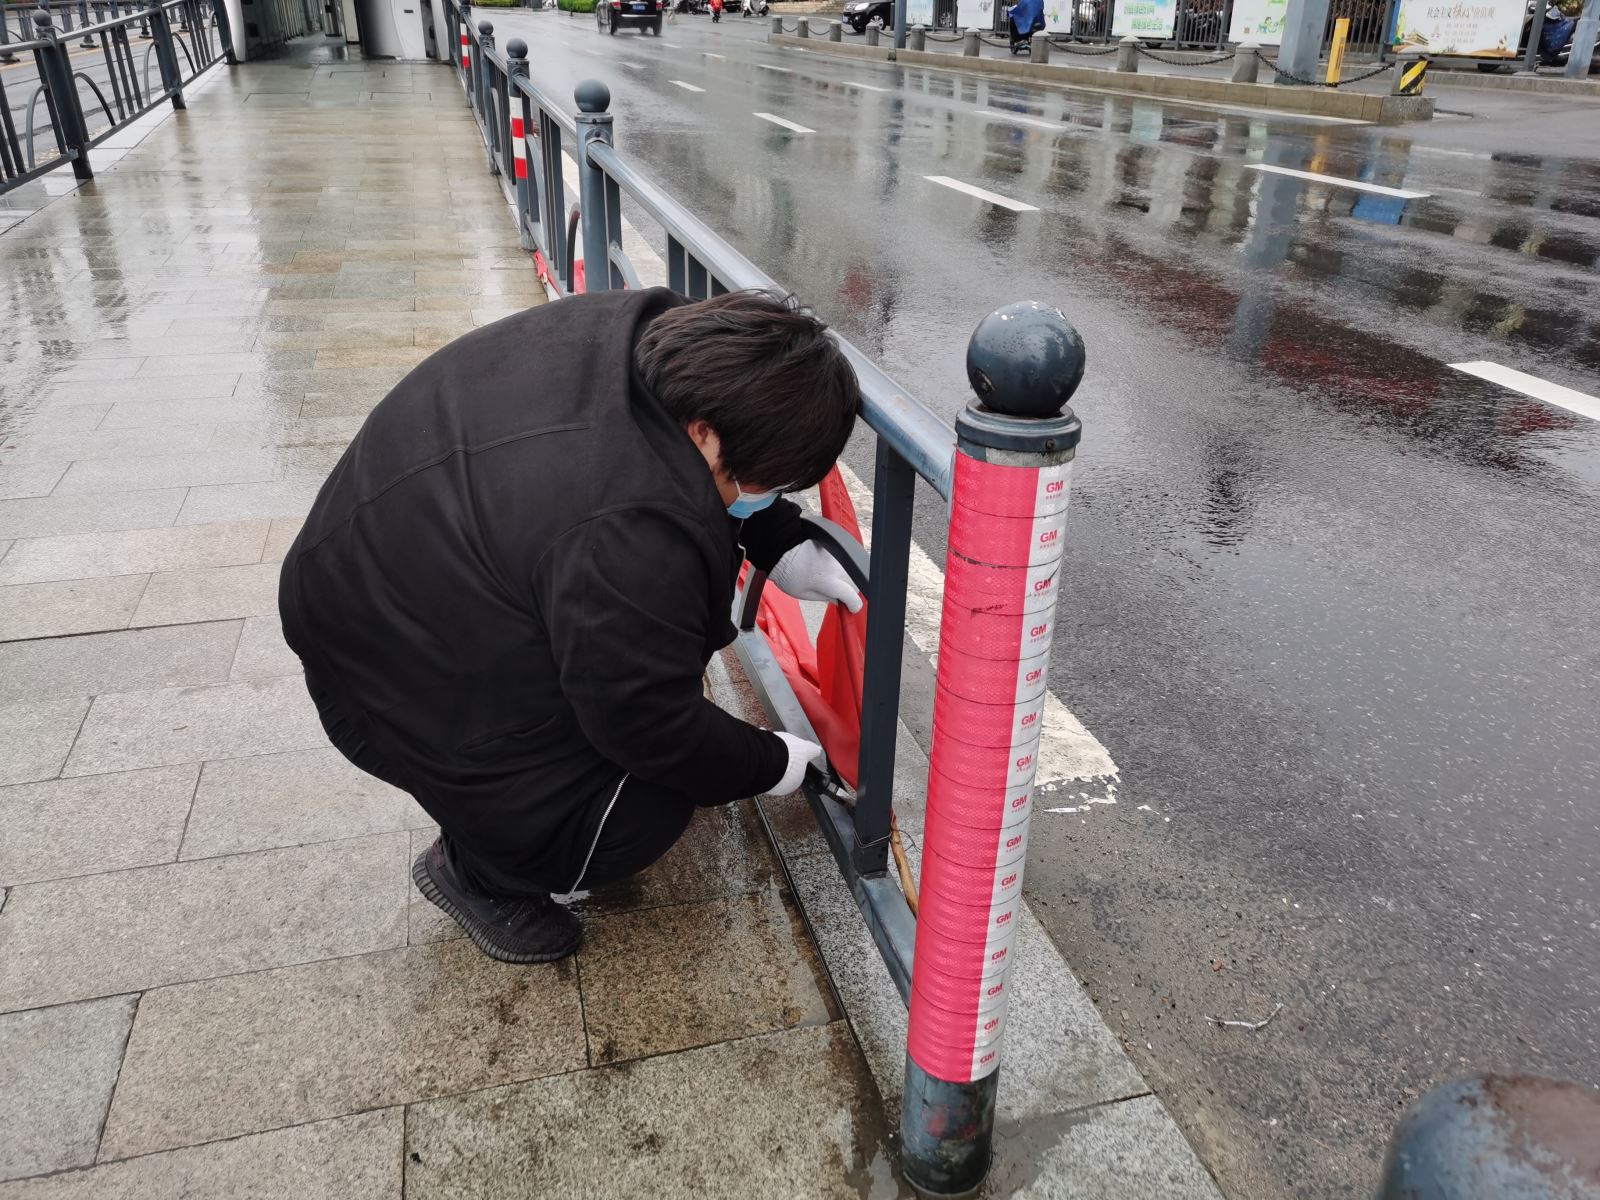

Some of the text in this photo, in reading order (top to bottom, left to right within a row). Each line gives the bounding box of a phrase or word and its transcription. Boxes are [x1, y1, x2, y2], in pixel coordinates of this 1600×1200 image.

[1046, 480, 1064, 494] GM
[1040, 529, 1057, 542] GM
[1034, 579, 1051, 592] GM
[1030, 624, 1048, 636] GM
[1025, 668, 1041, 681] GM
[1021, 712, 1037, 725] GM
[1016, 755, 1032, 767] GM
[1012, 795, 1027, 808] GM
[1007, 835, 1021, 847] GM
[1002, 874, 1016, 886] GM
[997, 911, 1011, 924] GM
[992, 947, 1007, 960] GM
[987, 984, 1003, 996] GM
[984, 1018, 999, 1030] GM
[980, 1051, 995, 1063] GM
